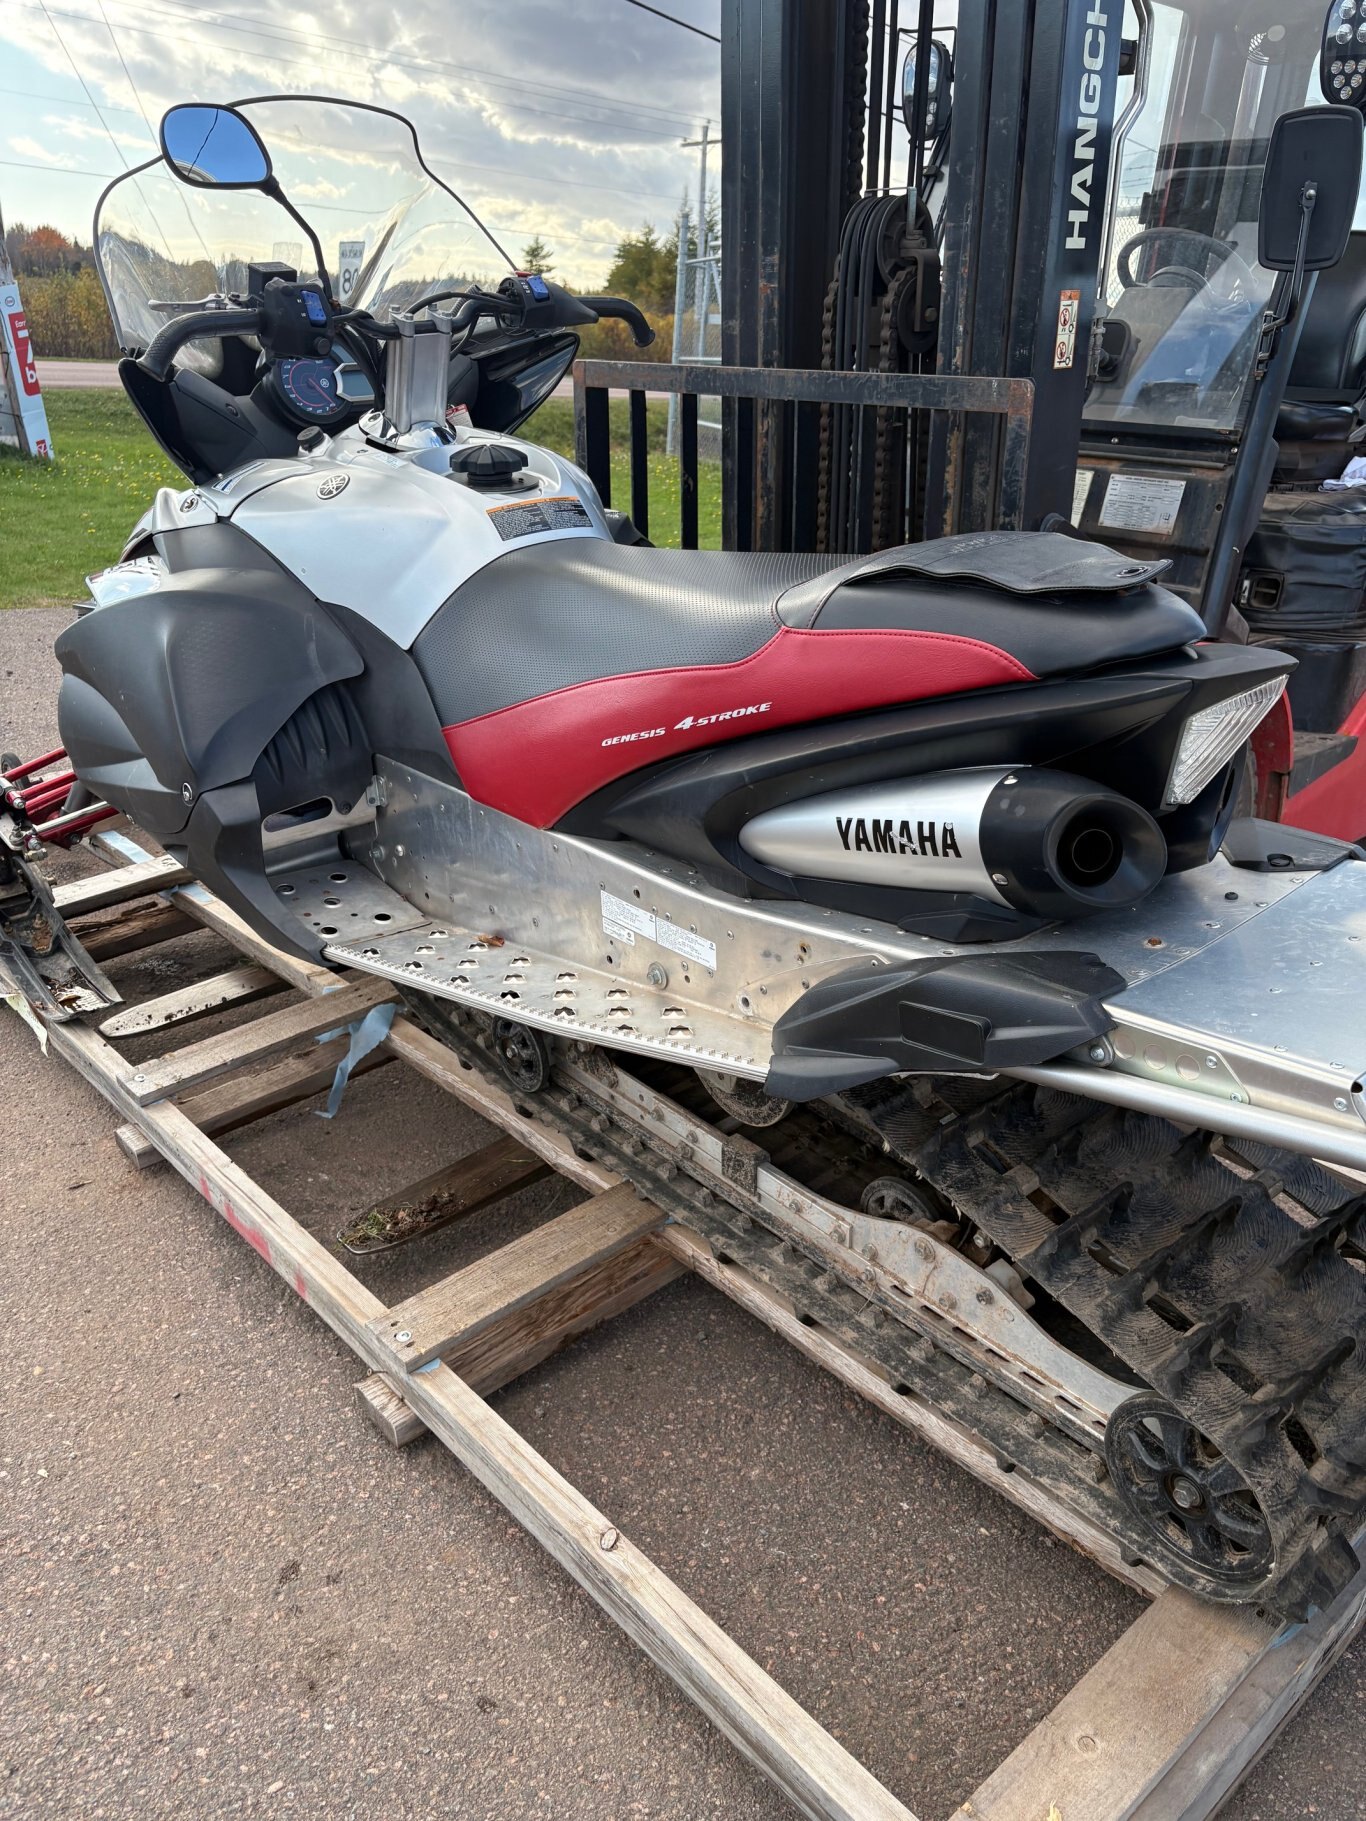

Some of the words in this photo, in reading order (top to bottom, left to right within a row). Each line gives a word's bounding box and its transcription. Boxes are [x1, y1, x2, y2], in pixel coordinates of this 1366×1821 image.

[601, 727, 666, 747] GENESIS
[673, 701, 773, 730] 4-STROKE
[836, 816, 963, 859] YAMAHA
